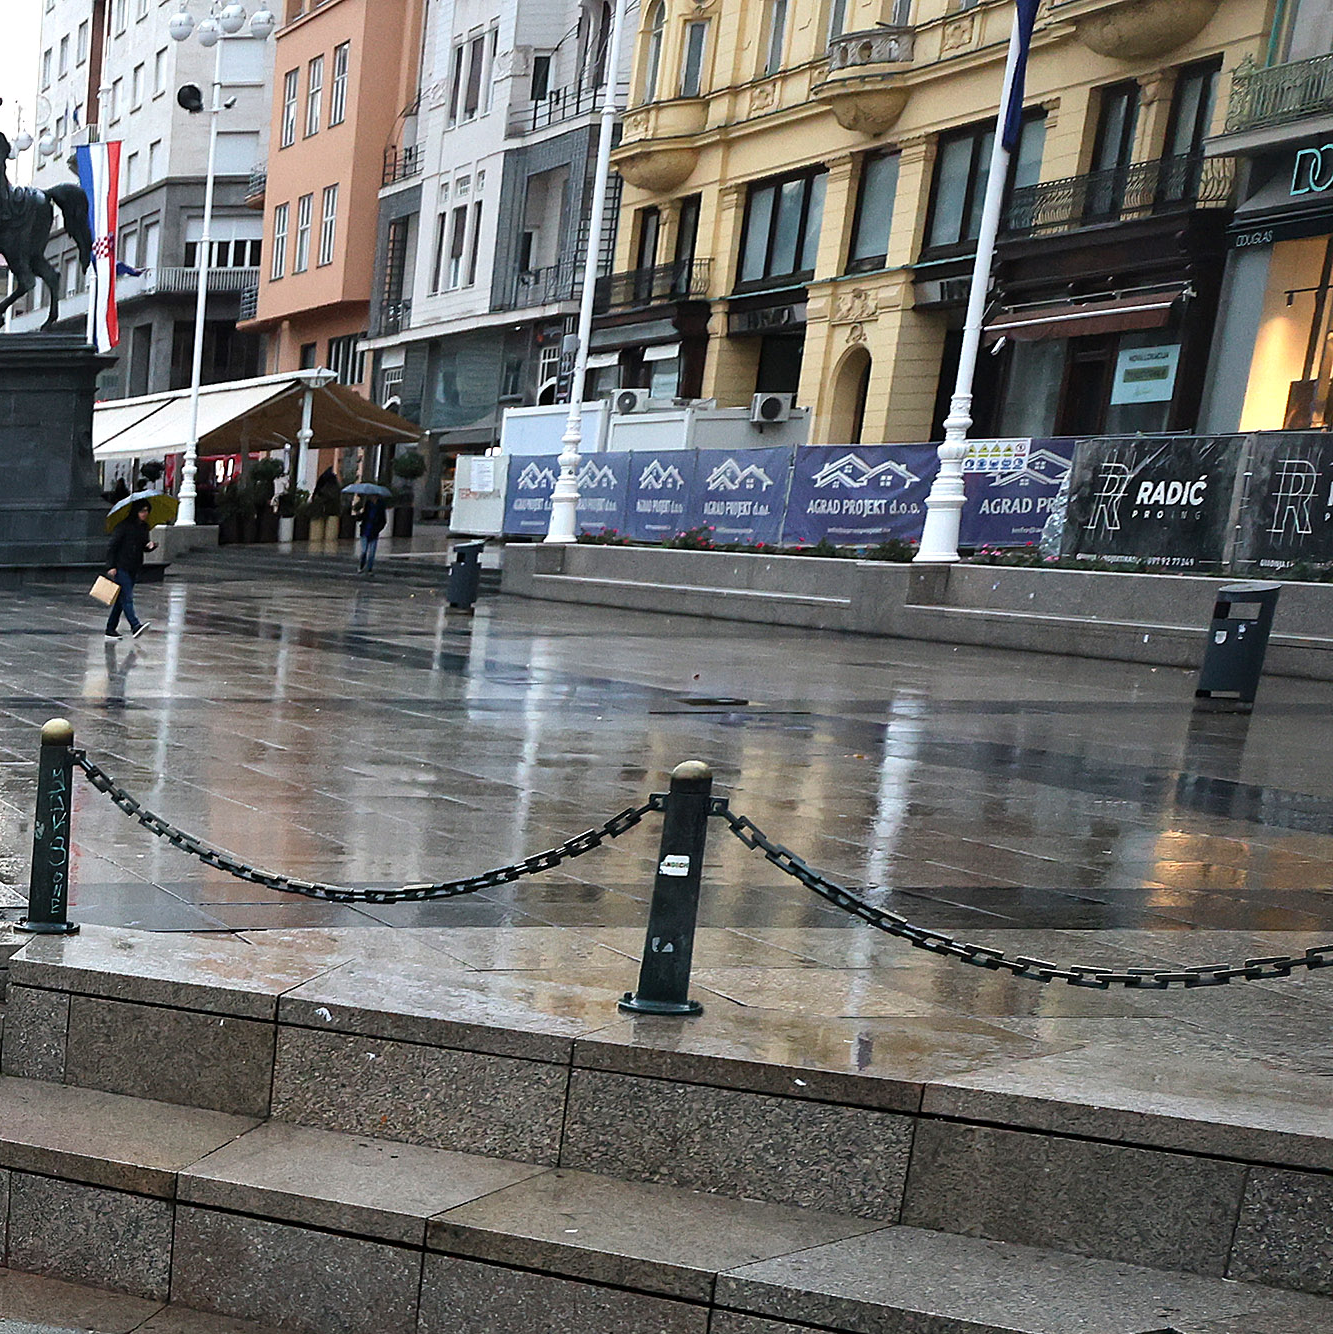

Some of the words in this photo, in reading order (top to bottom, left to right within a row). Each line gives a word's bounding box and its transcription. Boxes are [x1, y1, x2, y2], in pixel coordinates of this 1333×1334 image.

[1236, 230, 1273, 247] DOUGLAS
[1135, 474, 1208, 506] RADIĆ
[807, 499, 841, 514] AGRAD
[843, 499, 887, 518] PROJEKT
[890, 500, 920, 515] d.o.o.
[979, 498, 1032, 514] AGRAD
